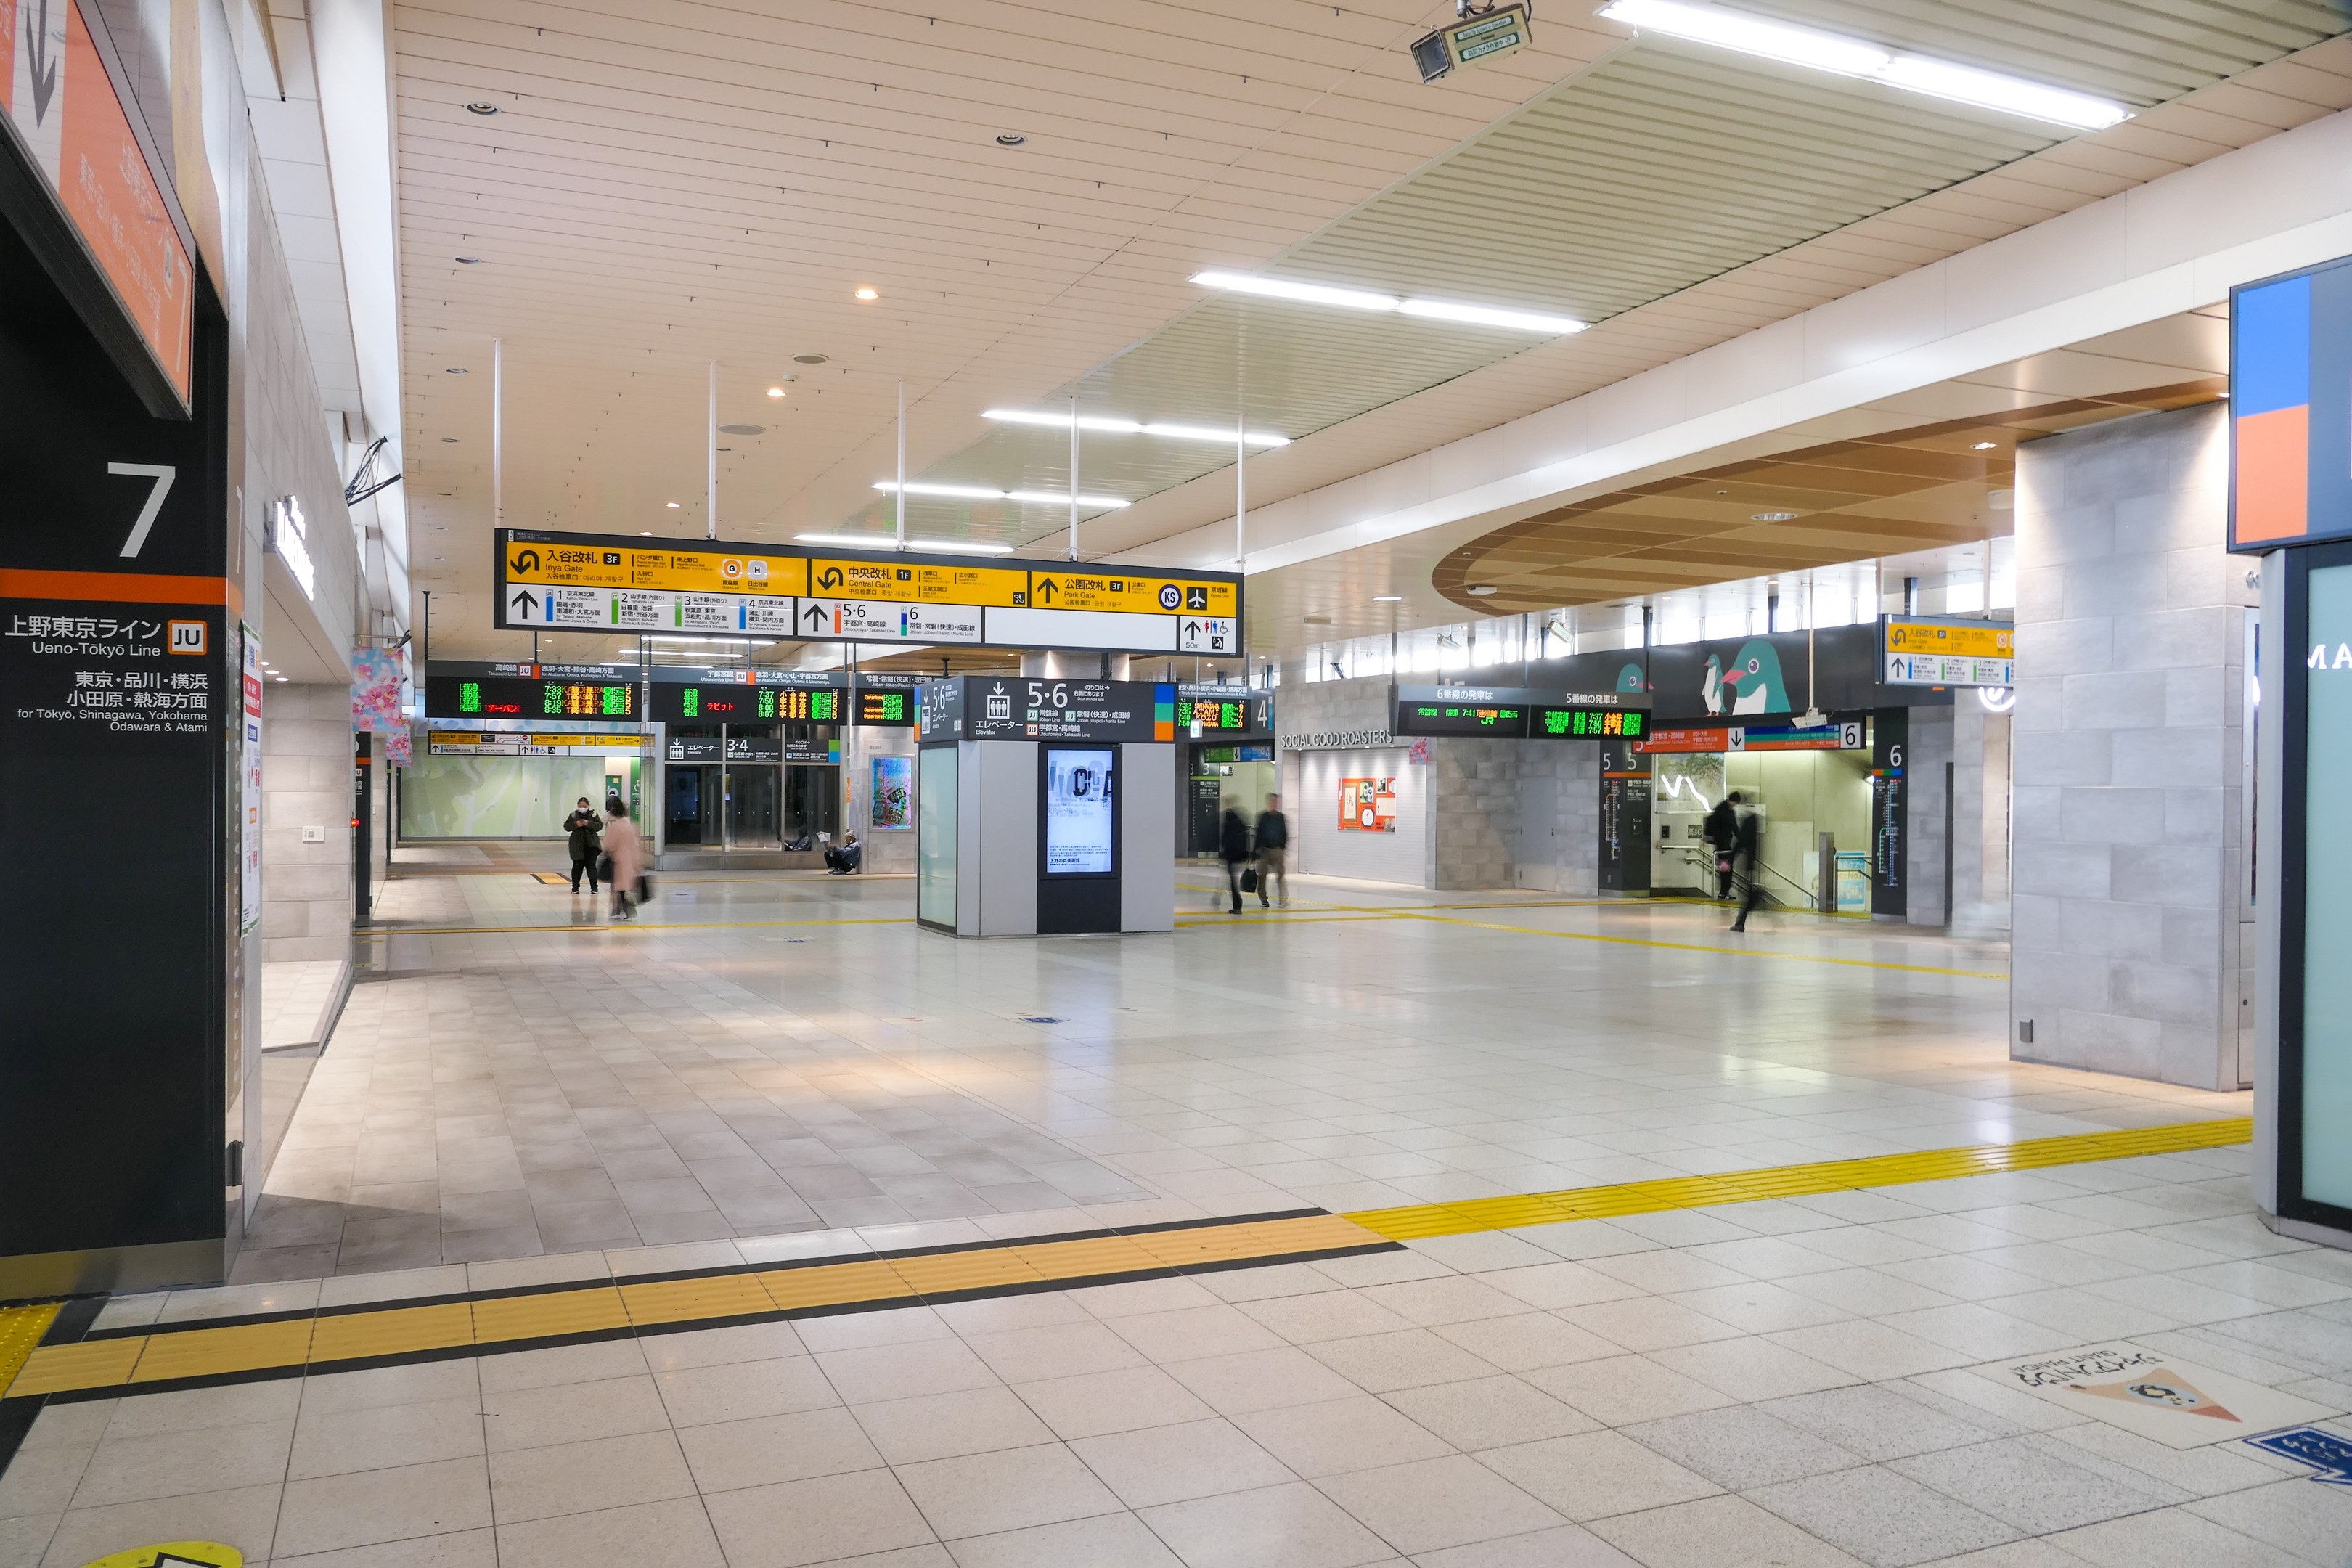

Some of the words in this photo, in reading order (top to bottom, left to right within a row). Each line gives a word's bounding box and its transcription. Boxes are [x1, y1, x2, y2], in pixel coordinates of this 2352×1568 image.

[107, 461, 176, 558] 7
[546, 550, 597, 564] 入谷改札
[606, 555, 618, 563] 3F
[545, 563, 562, 572] Iriya
[848, 567, 892, 580] 中央改札
[899, 571, 910, 579] 1F
[1064, 578, 1106, 592] 公園改札
[1111, 582, 1122, 591] 3F
[558, 589, 563, 600] 1
[621, 592, 628, 603] 2
[685, 596, 691, 605] 3
[1164, 591, 1175, 604] KS
[748, 599, 756, 608] 4
[910, 606, 918, 620] 6
[4, 614, 162, 640] 上野東京ライン
[843, 619, 886, 628] 宇都宮・高崎線
[173, 629, 201, 647] JU
[1909, 628, 1935, 637] 入谷改札
[32, 641, 126, 658] Ueno-Tōkyō
[129, 644, 161, 657] Line
[542, 665, 615, 674] 赤羽・大宮・熊谷・高崎方面
[756, 671, 829, 680] 赤羽・大宮・小山・宇都宮方面
[75, 671, 208, 690] 東京・品川・横浜
[66, 690, 208, 709] 小田原・熱海方面
[1437, 688, 1493, 700] 6番線の発車は
[1566, 693, 1618, 704] 5番線の発車は
[17, 708, 33, 719] for
[36, 709, 75, 722] Tōkyō,
[78, 709, 145, 722] Shinagawa,
[147, 710, 208, 721] Yokohama
[1257, 699, 1267, 727] 4
[1462, 709, 1476, 717] 7:41
[110, 722, 161, 732] Odawara
[164, 722, 173, 732] &
[176, 722, 208, 732] Atami
[976, 720, 1024, 730] エレベーター
[1480, 716, 1495, 725] JR
[1039, 724, 1081, 732] 宇都宮・高崎線
[1281, 733, 1312, 748] SOCIAL
[1312, 732, 1341, 747] GOOD
[1342, 729, 1392, 746] ROASTERS
[1845, 724, 1856, 746] 6
[1603, 753, 1611, 771] 5
[1628, 752, 1637, 771] 5
[1890, 744, 1903, 767] 6
[1202, 763, 1209, 775] 3
[2069, 1349, 2117, 1363] GIANT
[2009, 1359, 2070, 1373] PANDA
[2020, 1352, 2164, 1387] ジャイアントパンダ
